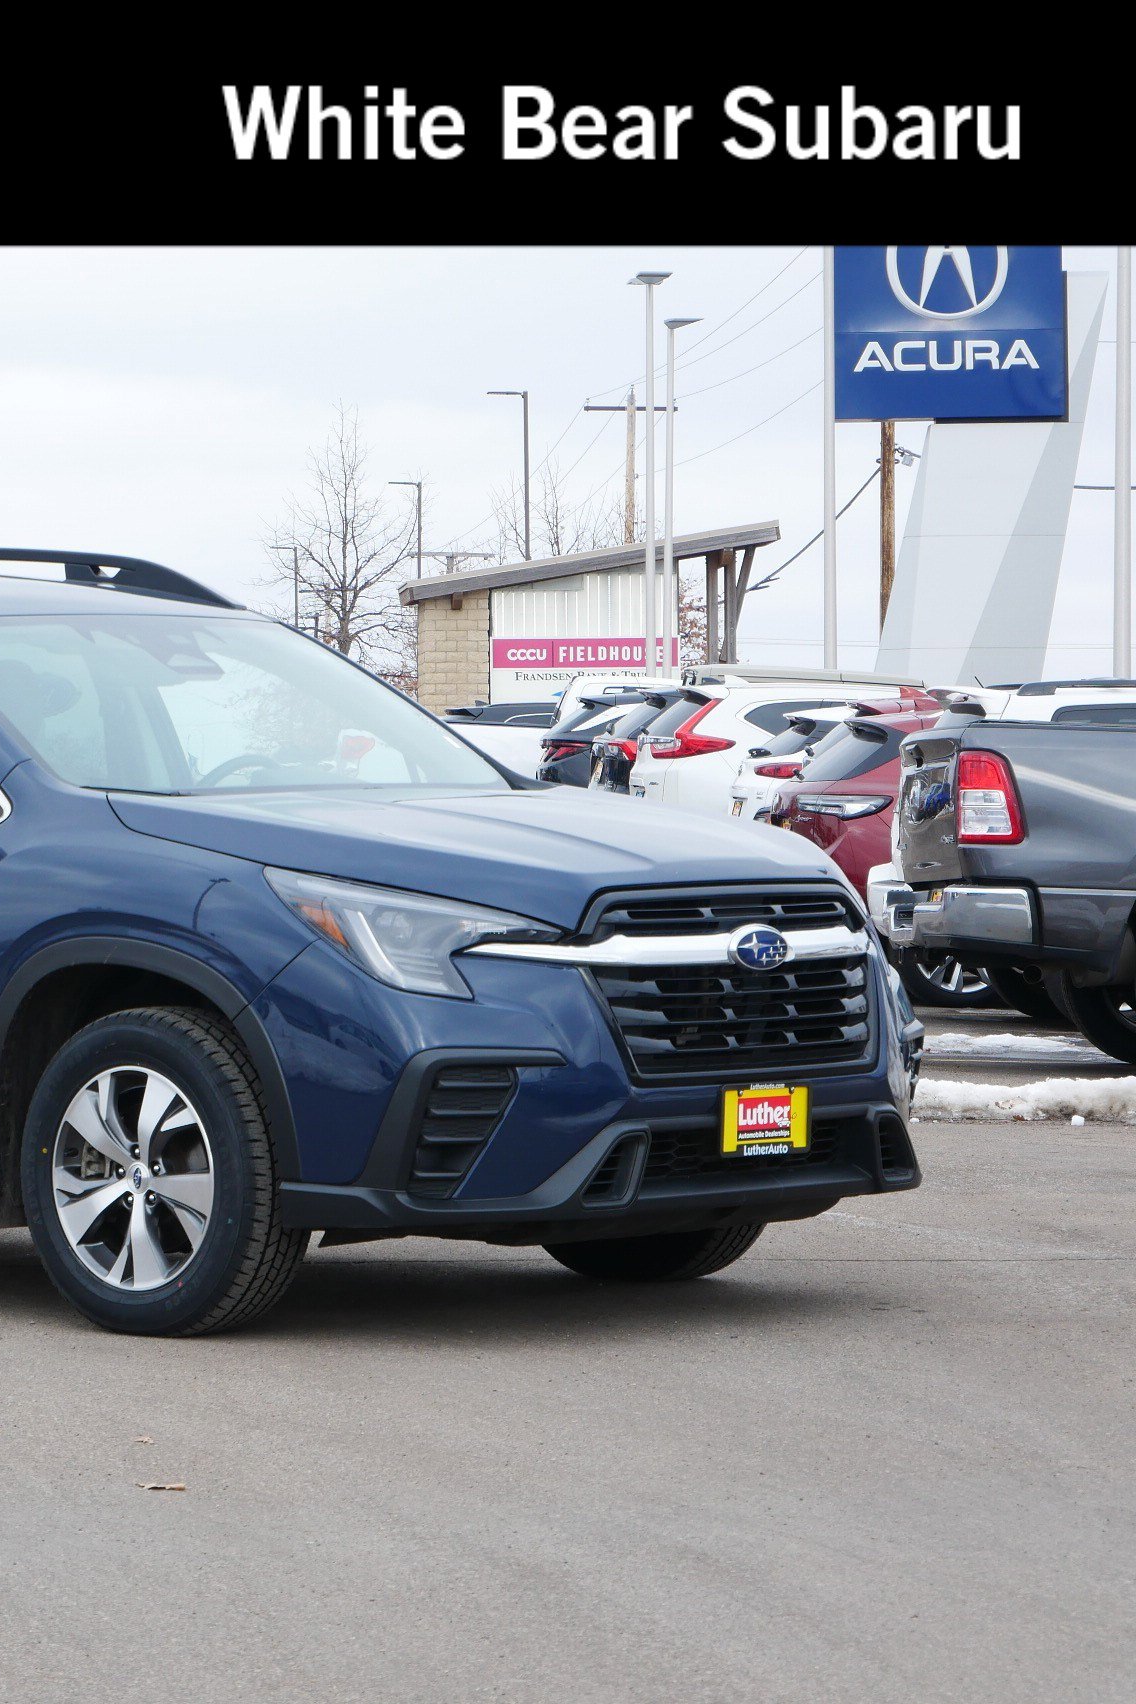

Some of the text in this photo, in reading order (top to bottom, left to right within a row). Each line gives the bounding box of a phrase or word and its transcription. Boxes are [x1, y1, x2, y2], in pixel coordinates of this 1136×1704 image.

[853, 339, 1040, 372] ACURA
[507, 645, 664, 663] CCCU FIELDHOUE
[750, 1083, 785, 1091] LutherAuto.com
[738, 1101, 791, 1126] Luther
[744, 1143, 789, 1156] LutherAuto
